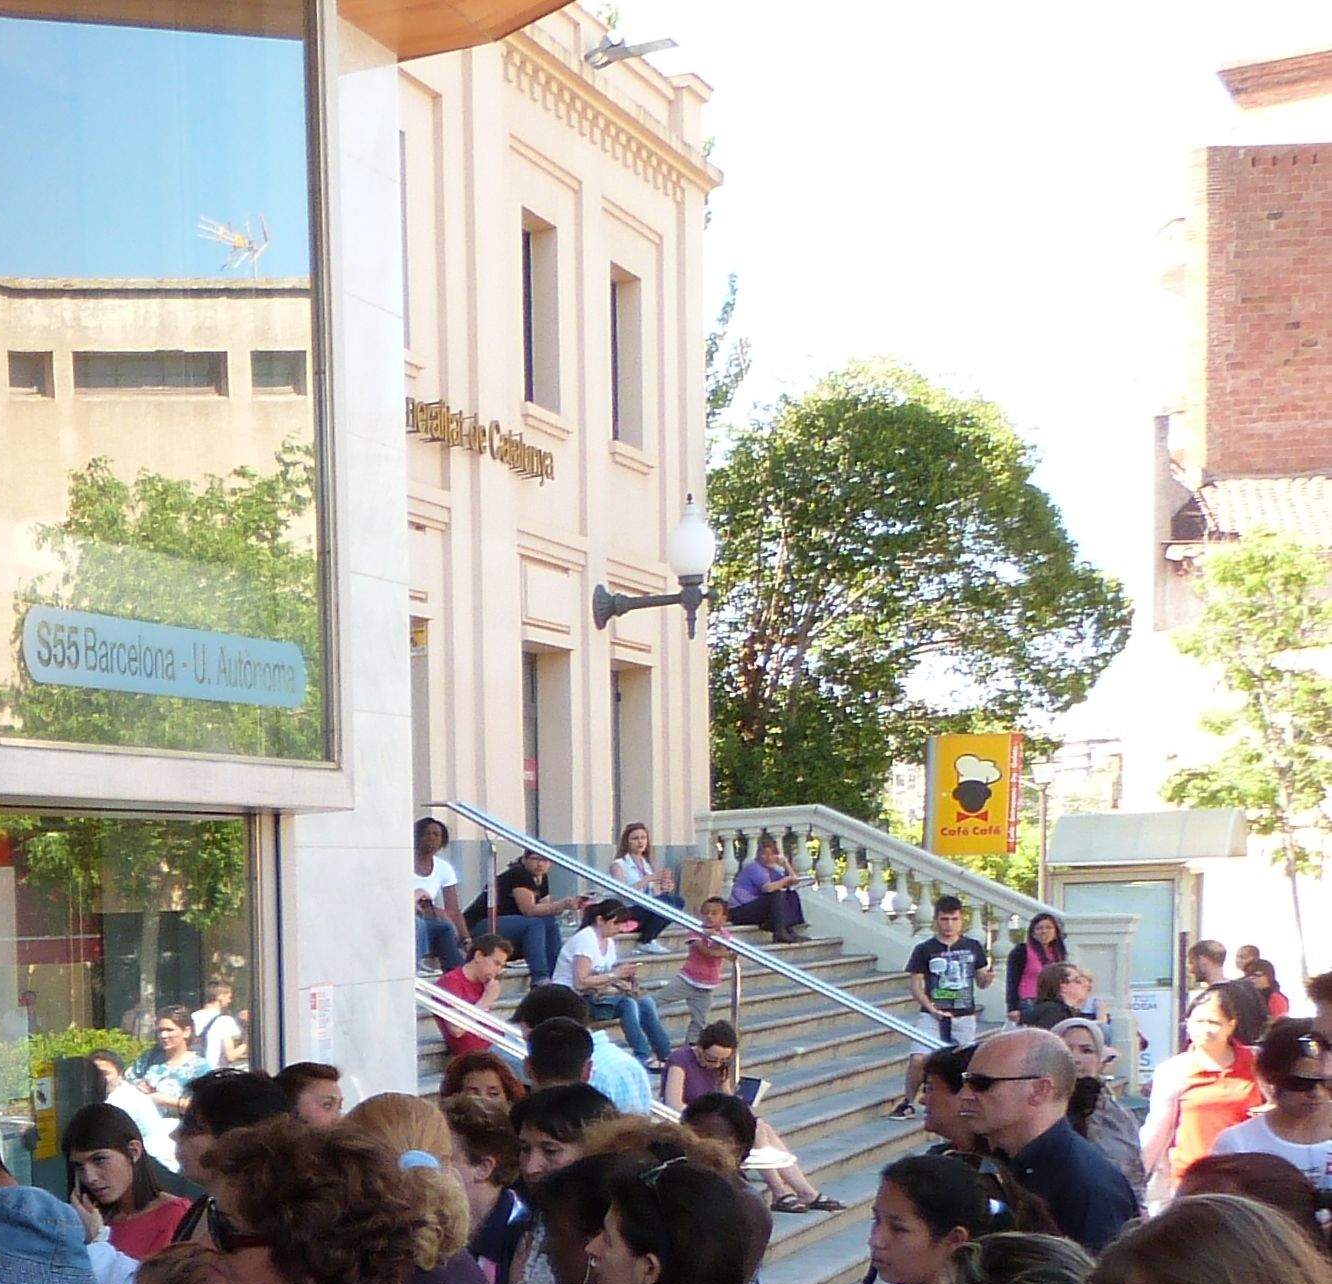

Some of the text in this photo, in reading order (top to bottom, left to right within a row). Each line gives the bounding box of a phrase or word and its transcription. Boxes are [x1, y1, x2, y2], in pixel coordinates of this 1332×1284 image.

[488, 419, 555, 487] Catalunya
[36, 619, 82, 672] S55
[84, 627, 177, 682] Barcelona
[940, 824, 1002, 837] Café Café
